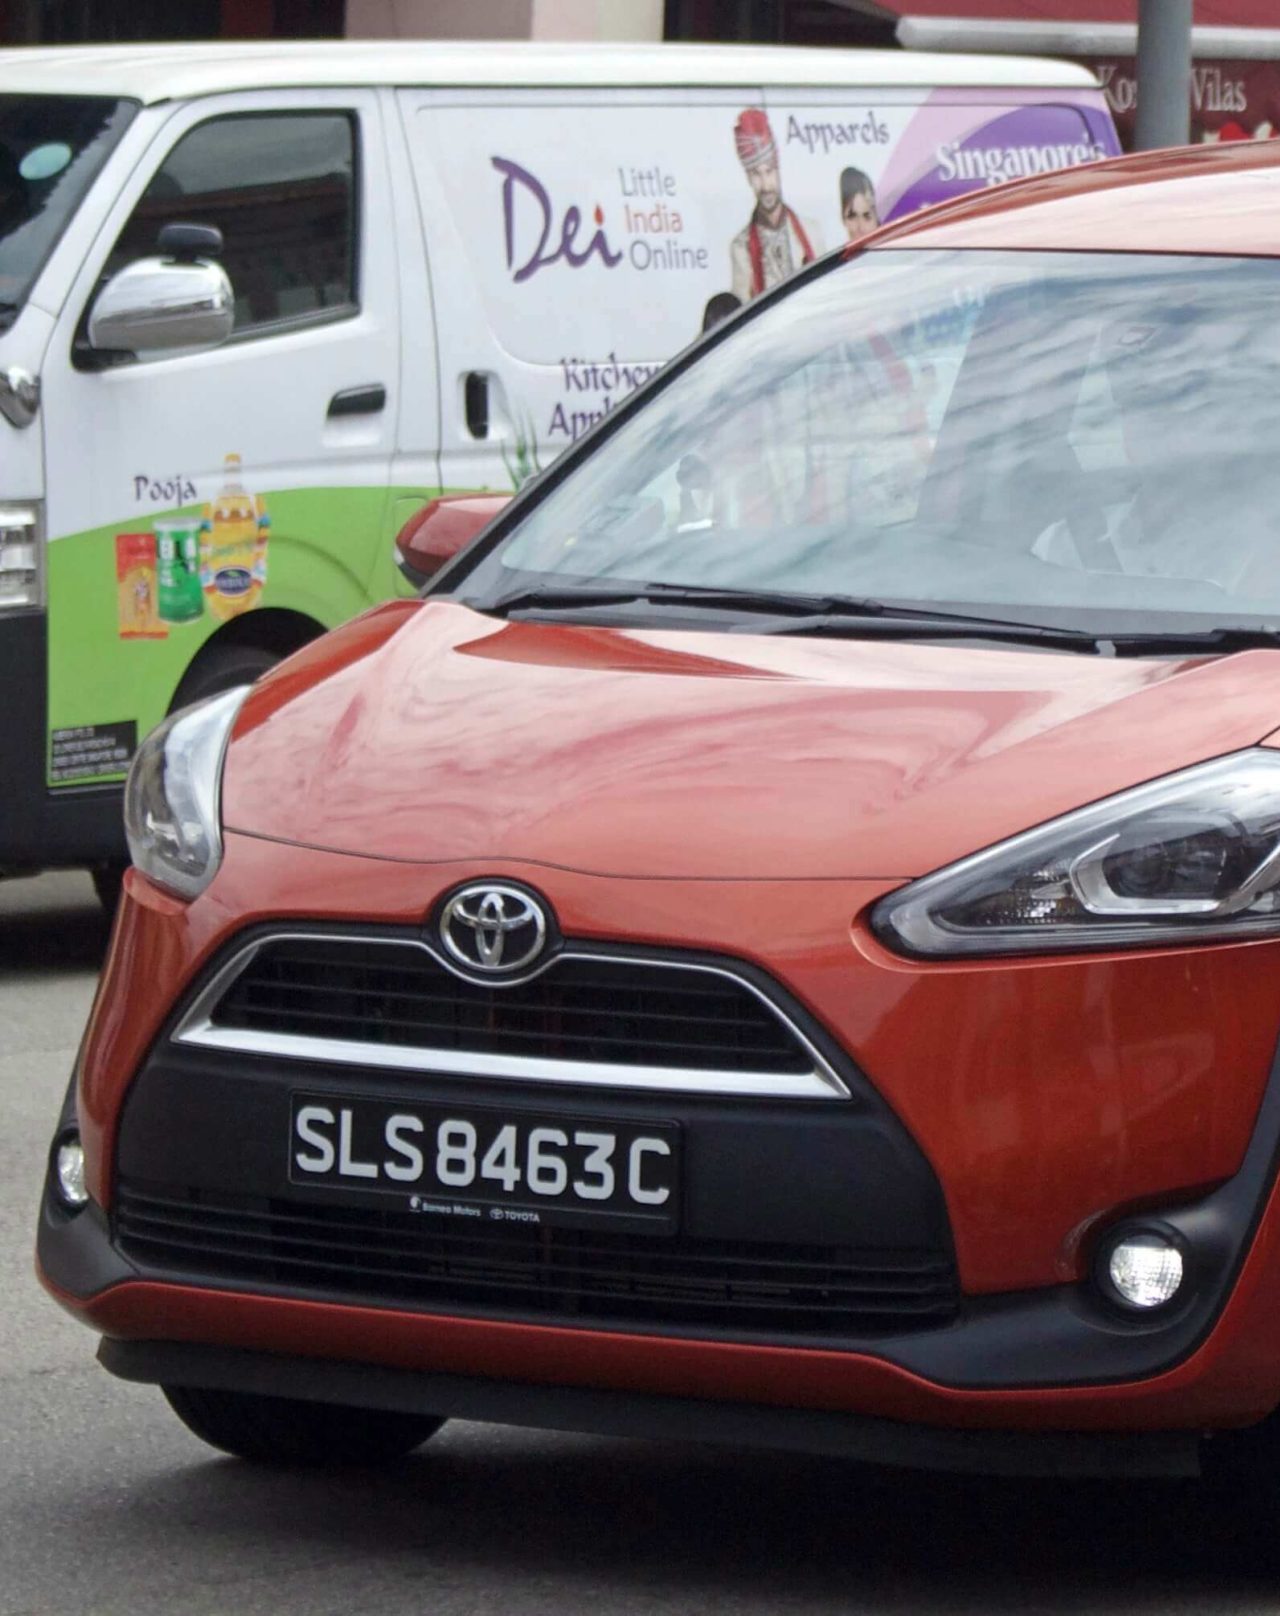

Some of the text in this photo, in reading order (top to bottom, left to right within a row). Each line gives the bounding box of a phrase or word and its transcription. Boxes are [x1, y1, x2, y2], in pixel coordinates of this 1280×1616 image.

[1190, 67, 1247, 112] Vilas
[936, 132, 1106, 186] Singapore's
[618, 167, 676, 197] Little
[490, 155, 622, 283] Dei
[625, 204, 683, 233] India
[630, 240, 709, 270] Online
[134, 475, 197, 506] Pooja
[504, 1210, 540, 1222] TOYOTA
